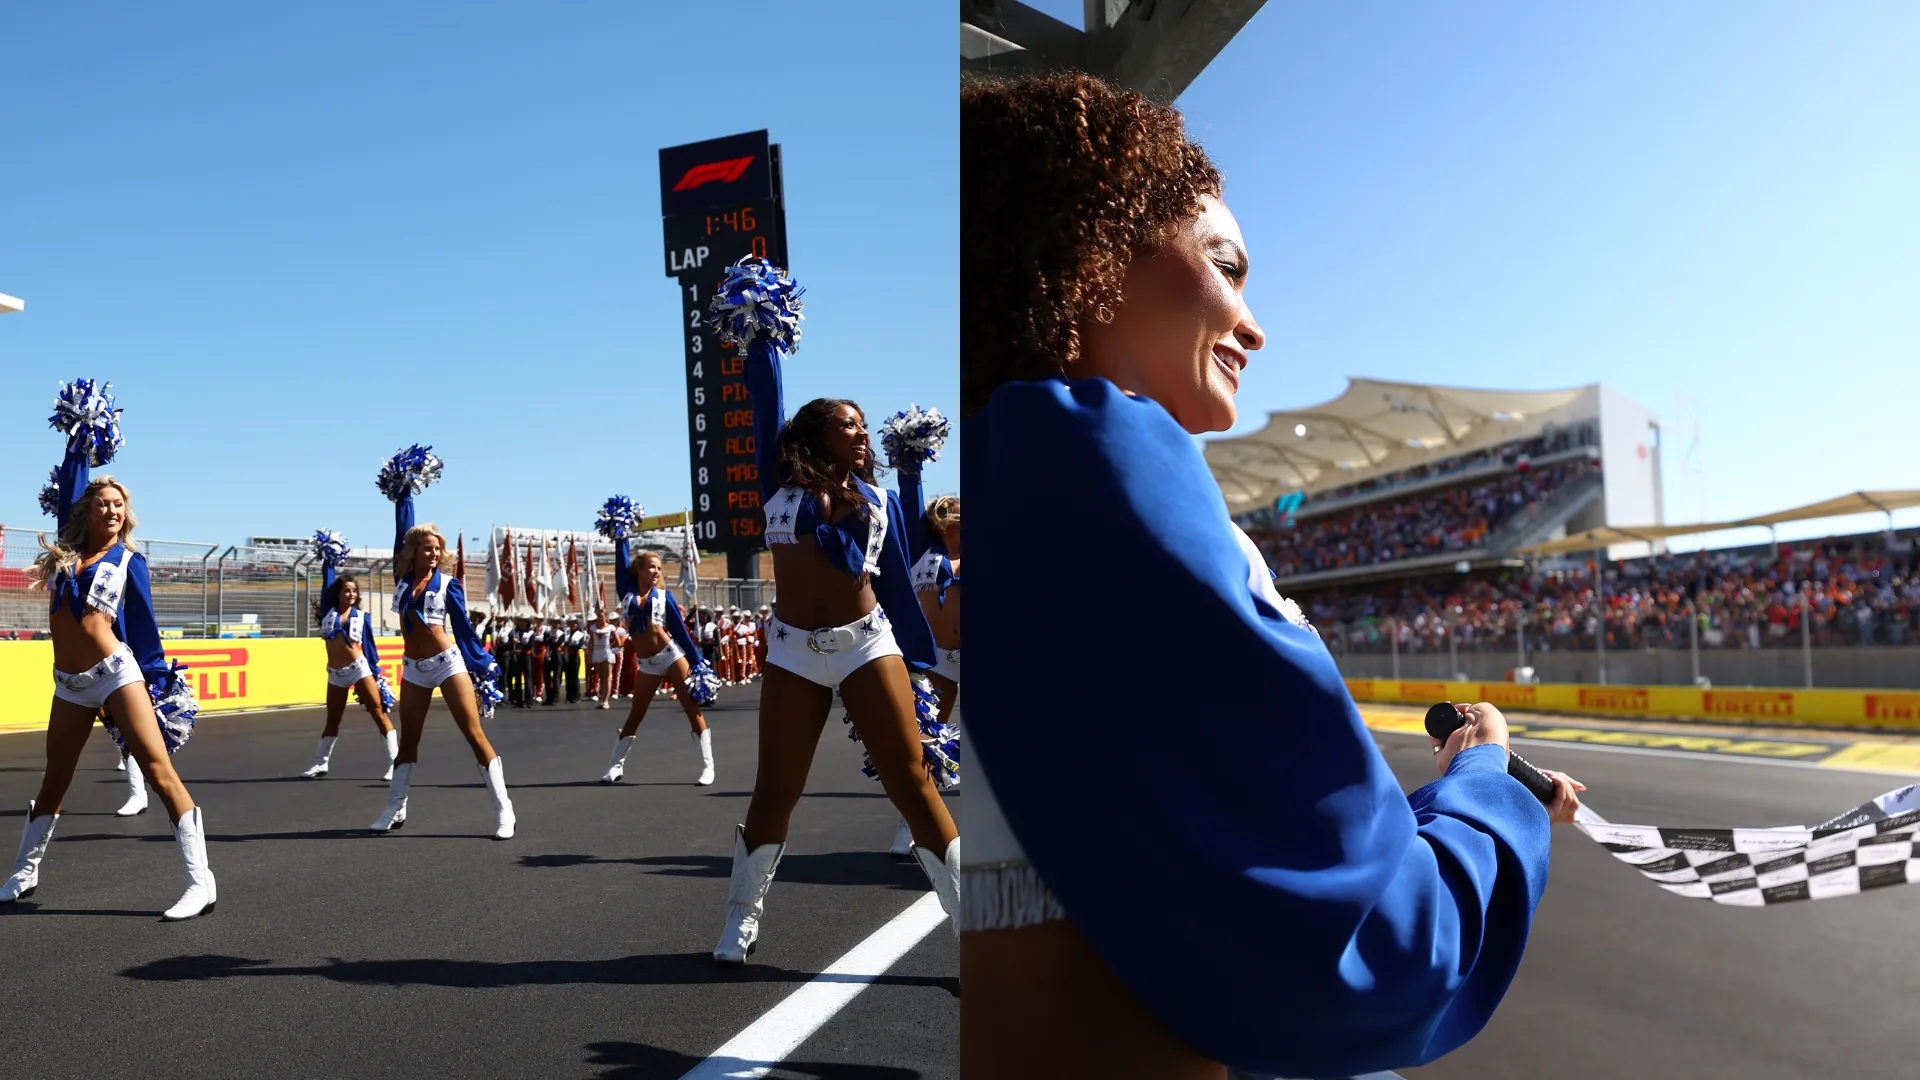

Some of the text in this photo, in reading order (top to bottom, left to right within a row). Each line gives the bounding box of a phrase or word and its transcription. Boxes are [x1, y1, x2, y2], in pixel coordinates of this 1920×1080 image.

[672, 155, 755, 191] F1
[706, 207, 756, 236] 1:46
[670, 236, 767, 271] LAP 0
[689, 284, 698, 302] 1
[690, 309, 701, 328] 2
[691, 335, 703, 353] 3
[692, 357, 745, 379] 4 LE
[694, 387, 705, 405] 5
[695, 410, 754, 432] 6 GAS
[696, 440, 707, 458] 7
[698, 464, 759, 485] 8 MAG
[699, 491, 760, 512] 9 PER
[695, 520, 717, 540] 10
[1703, 692, 1794, 716] PIRELLI
